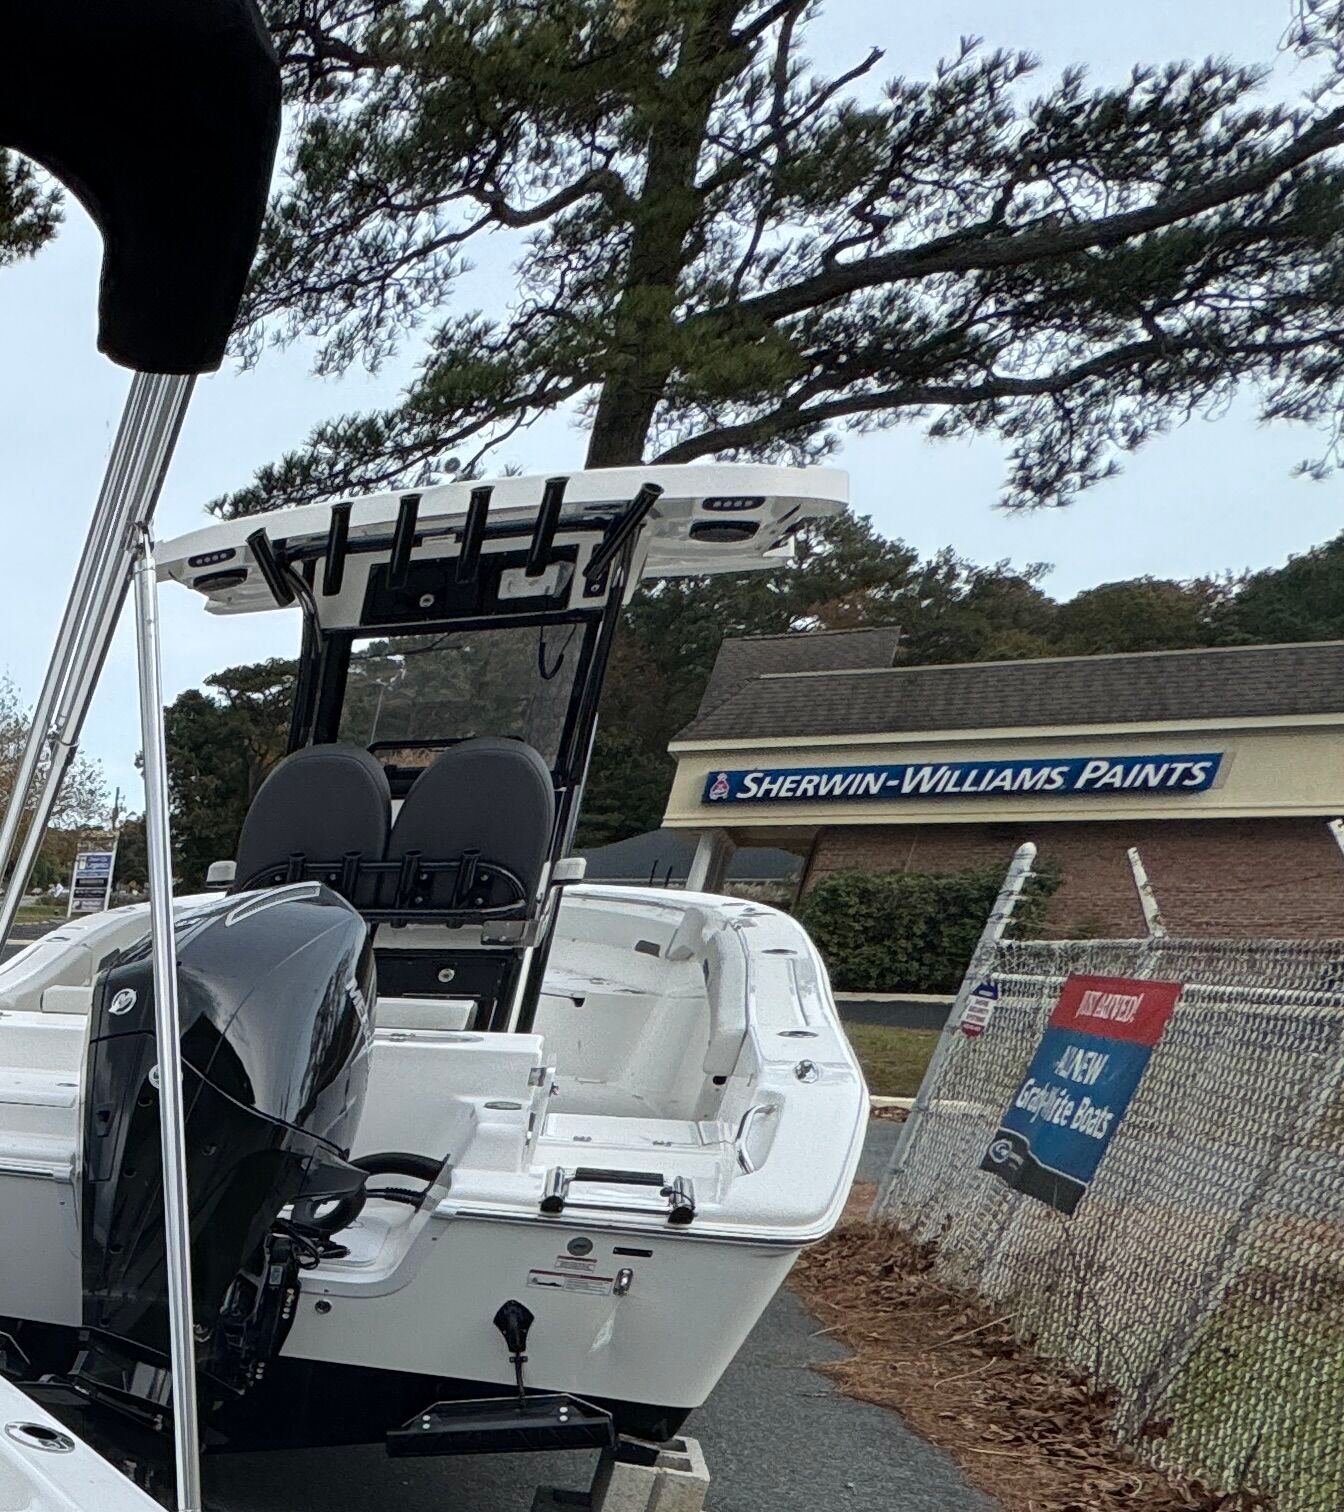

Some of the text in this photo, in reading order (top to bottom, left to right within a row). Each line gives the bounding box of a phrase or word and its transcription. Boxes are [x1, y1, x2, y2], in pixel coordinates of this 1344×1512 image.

[735, 759, 1211, 798] SHERWIN-WILLIAMS PAINTS
[1069, 1096, 1115, 1140] Boats
